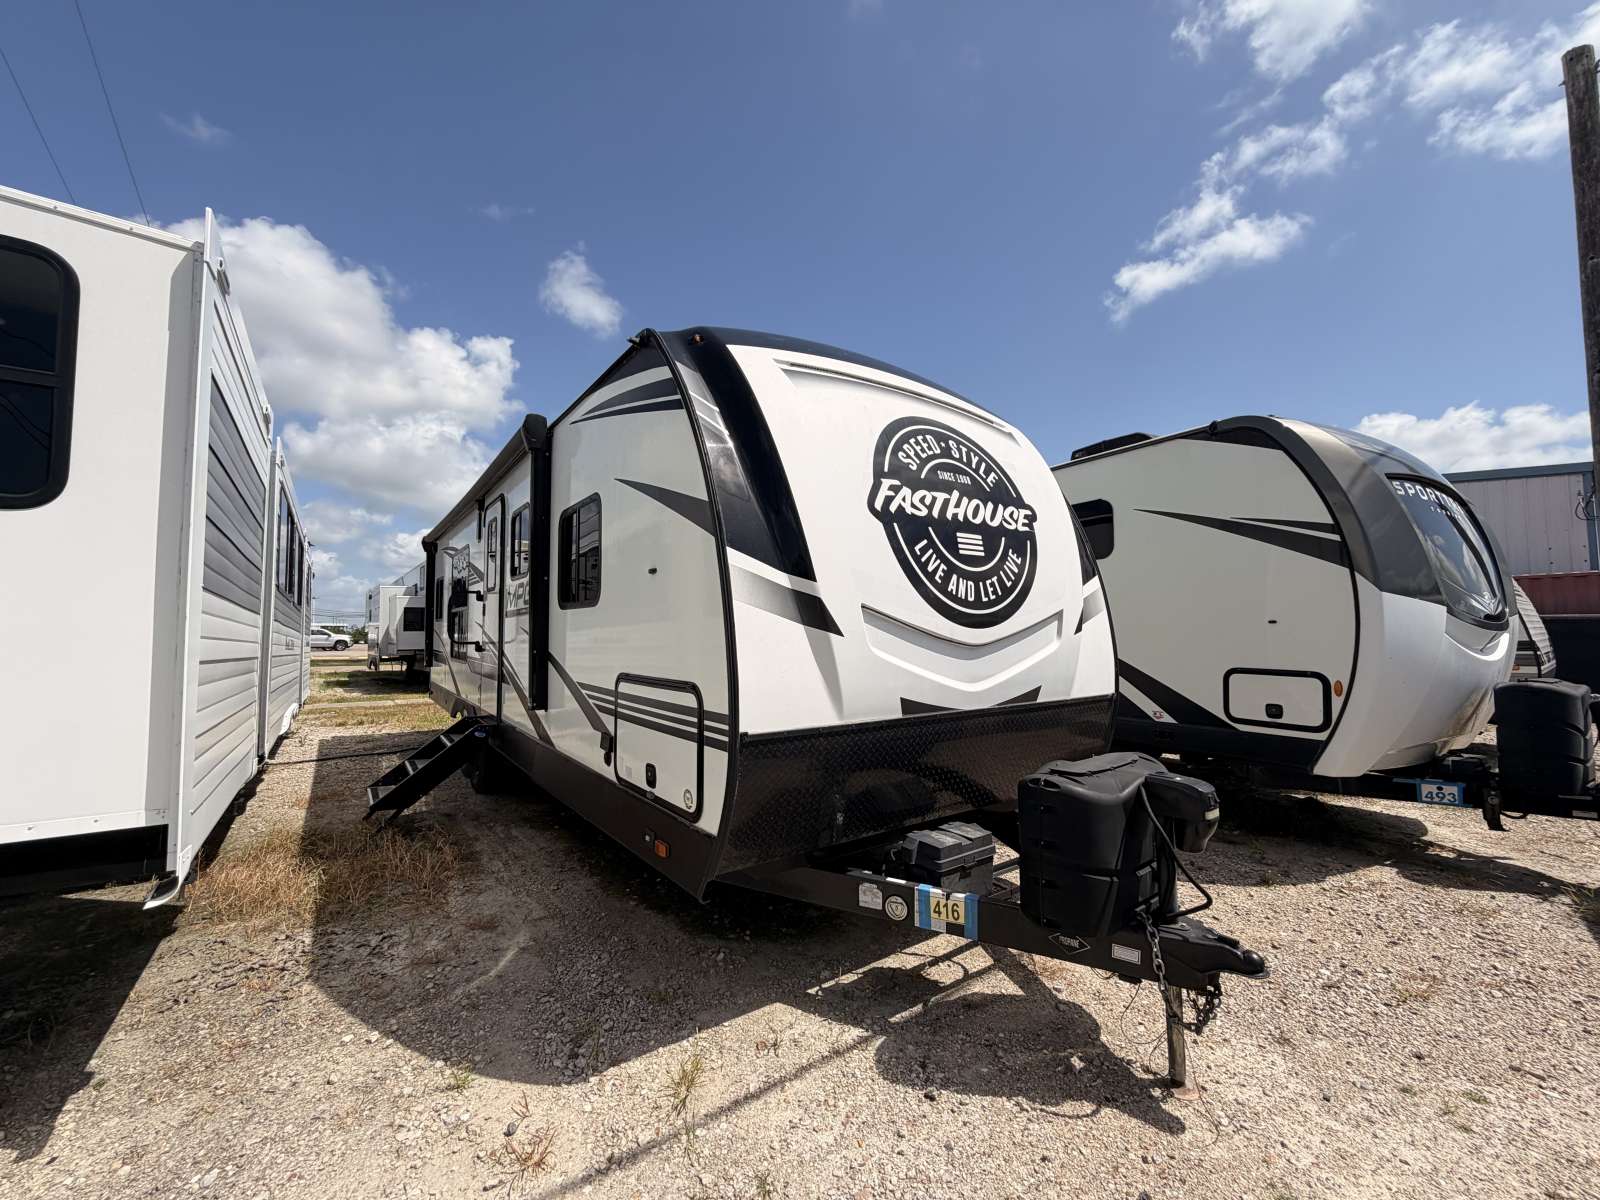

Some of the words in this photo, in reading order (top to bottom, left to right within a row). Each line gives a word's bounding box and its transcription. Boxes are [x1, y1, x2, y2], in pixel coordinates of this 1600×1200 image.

[898, 434, 941, 471] SPEED
[948, 440, 999, 487] STYLE
[874, 478, 1034, 532] FASTHOUSE
[914, 539, 948, 584] LIVE
[948, 574, 975, 602] AND
[980, 575, 1002, 602] LET
[1000, 548, 1022, 588] LIVE
[1424, 790, 1457, 803] 493
[933, 900, 960, 921] 416
